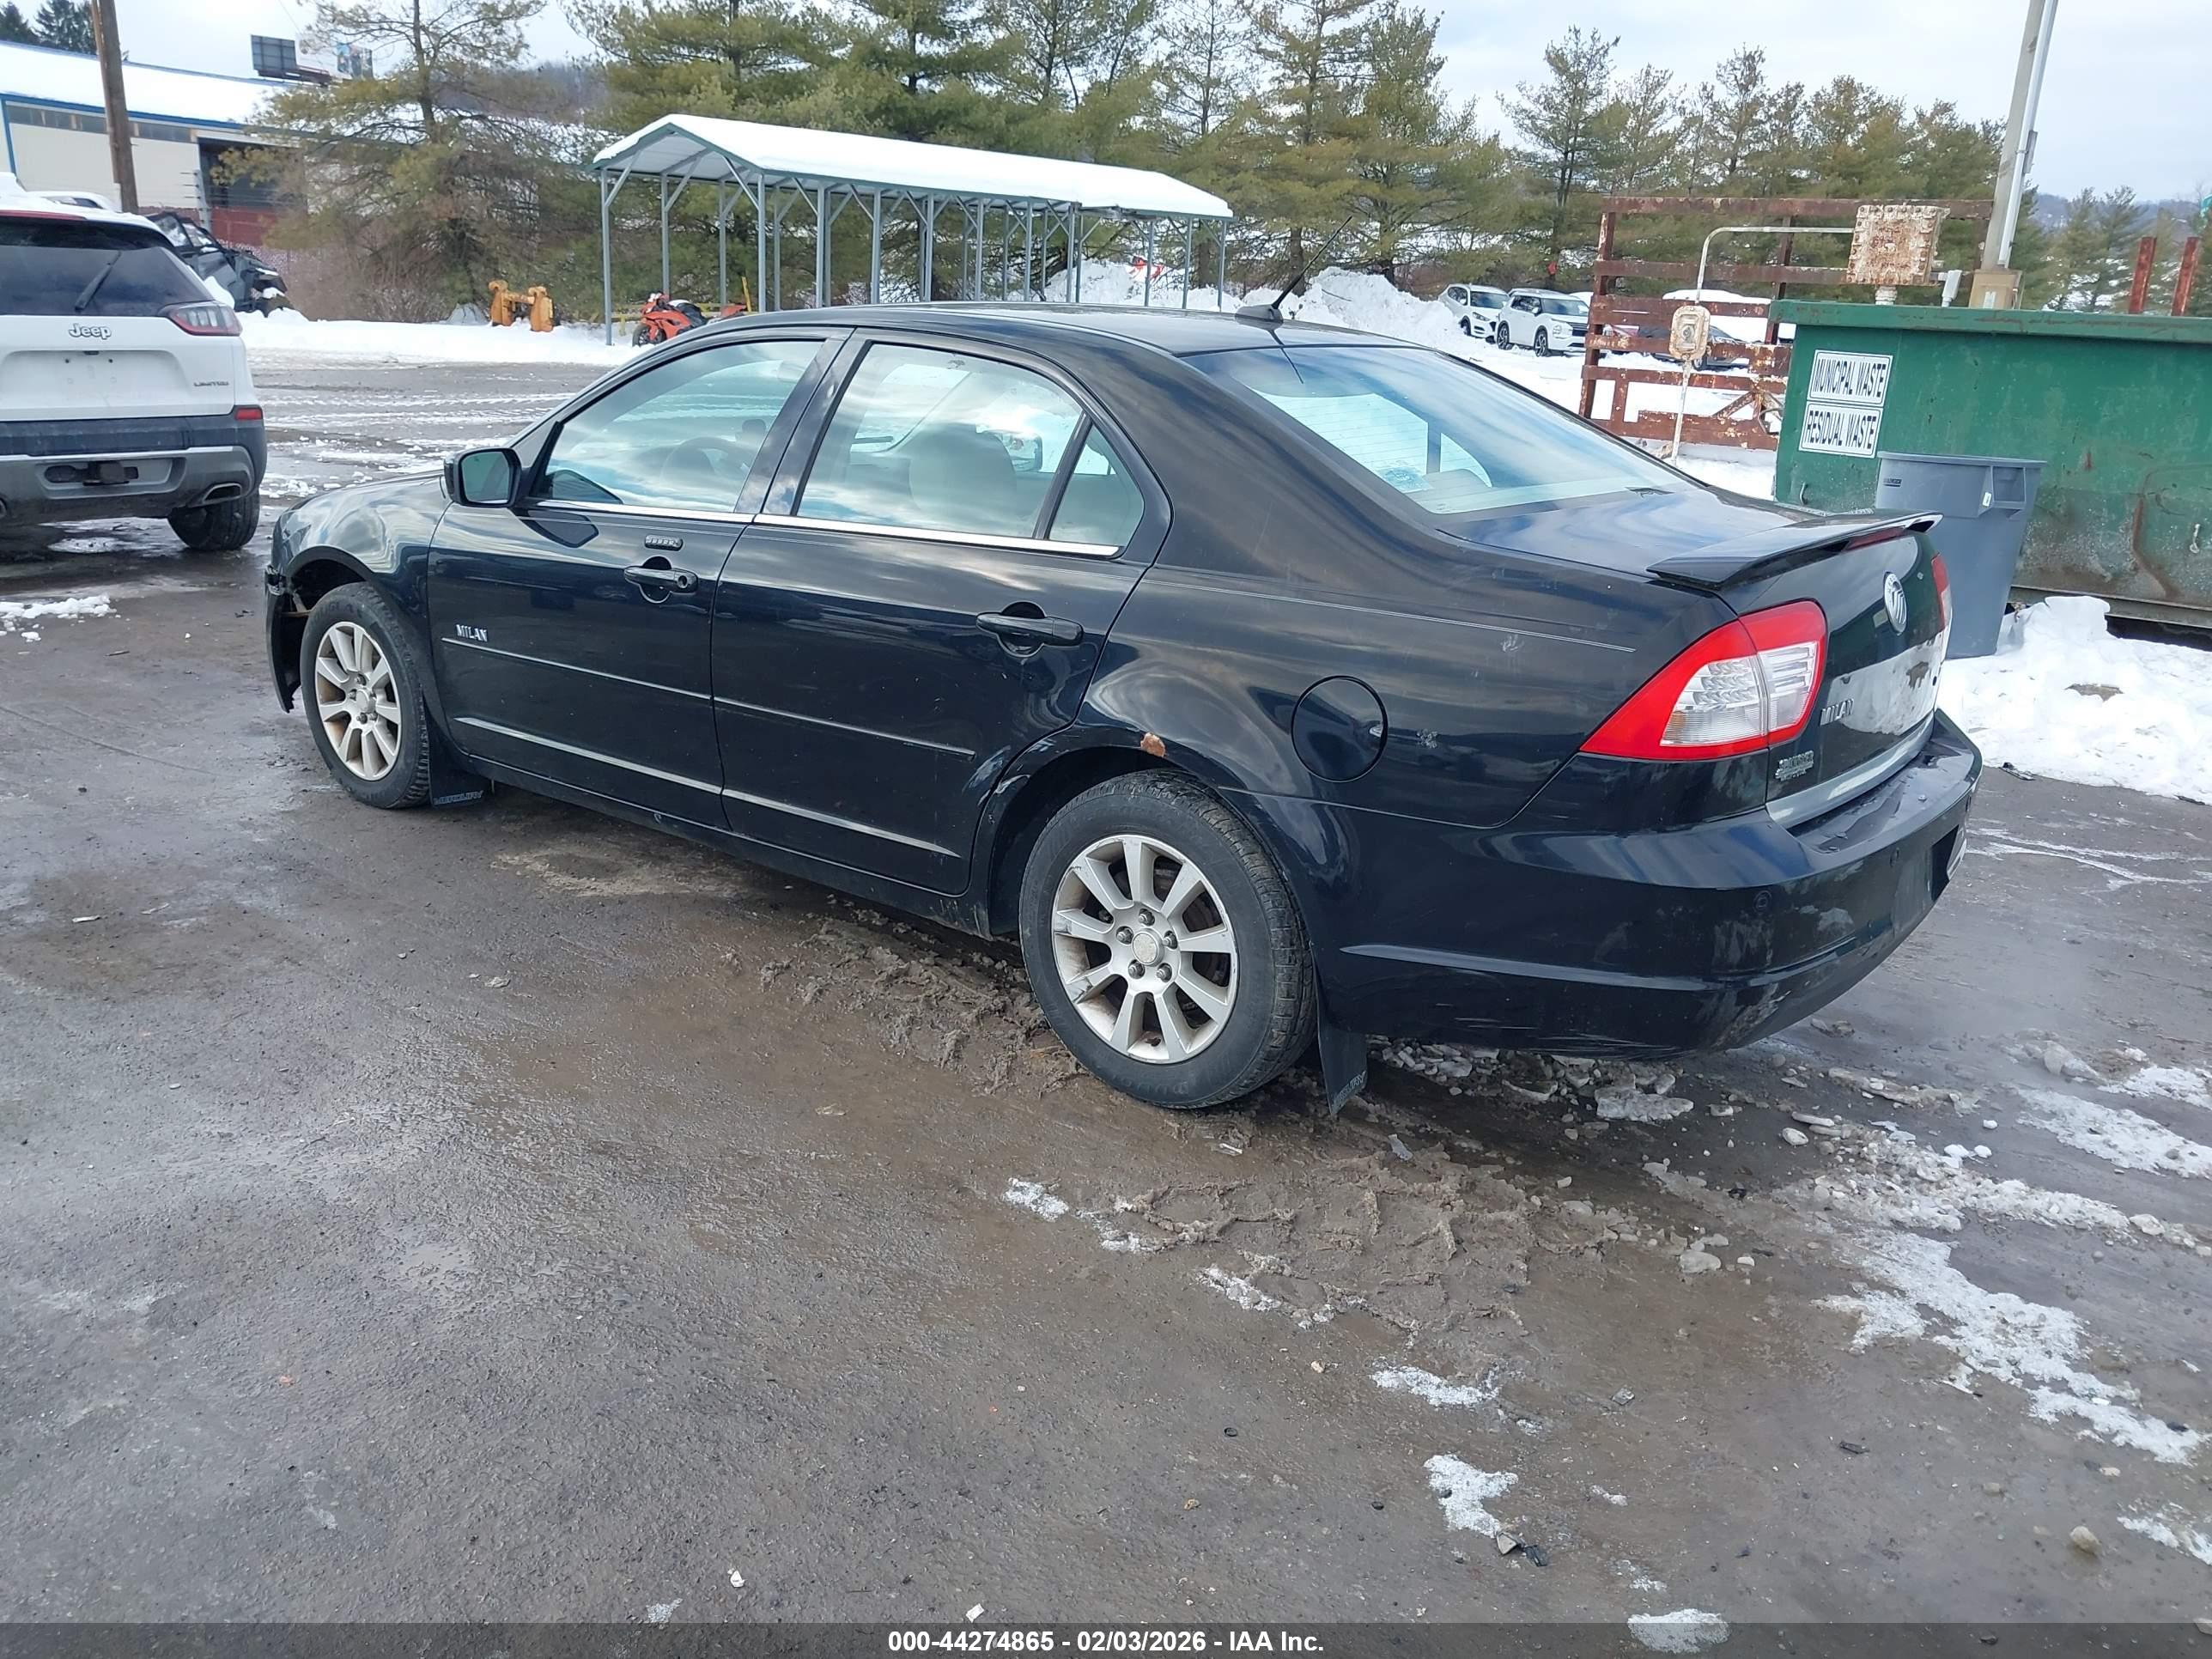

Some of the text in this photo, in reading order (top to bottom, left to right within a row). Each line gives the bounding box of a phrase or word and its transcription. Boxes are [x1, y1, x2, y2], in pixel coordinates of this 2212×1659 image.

[68, 323, 112, 340] Jeep
[1812, 359, 1887, 398] MUNICIPAL WASTE
[1804, 410, 1877, 449] RESIDUAL WASTE
[456, 624, 488, 642] MILAN
[1820, 698, 1855, 726] MILAN
